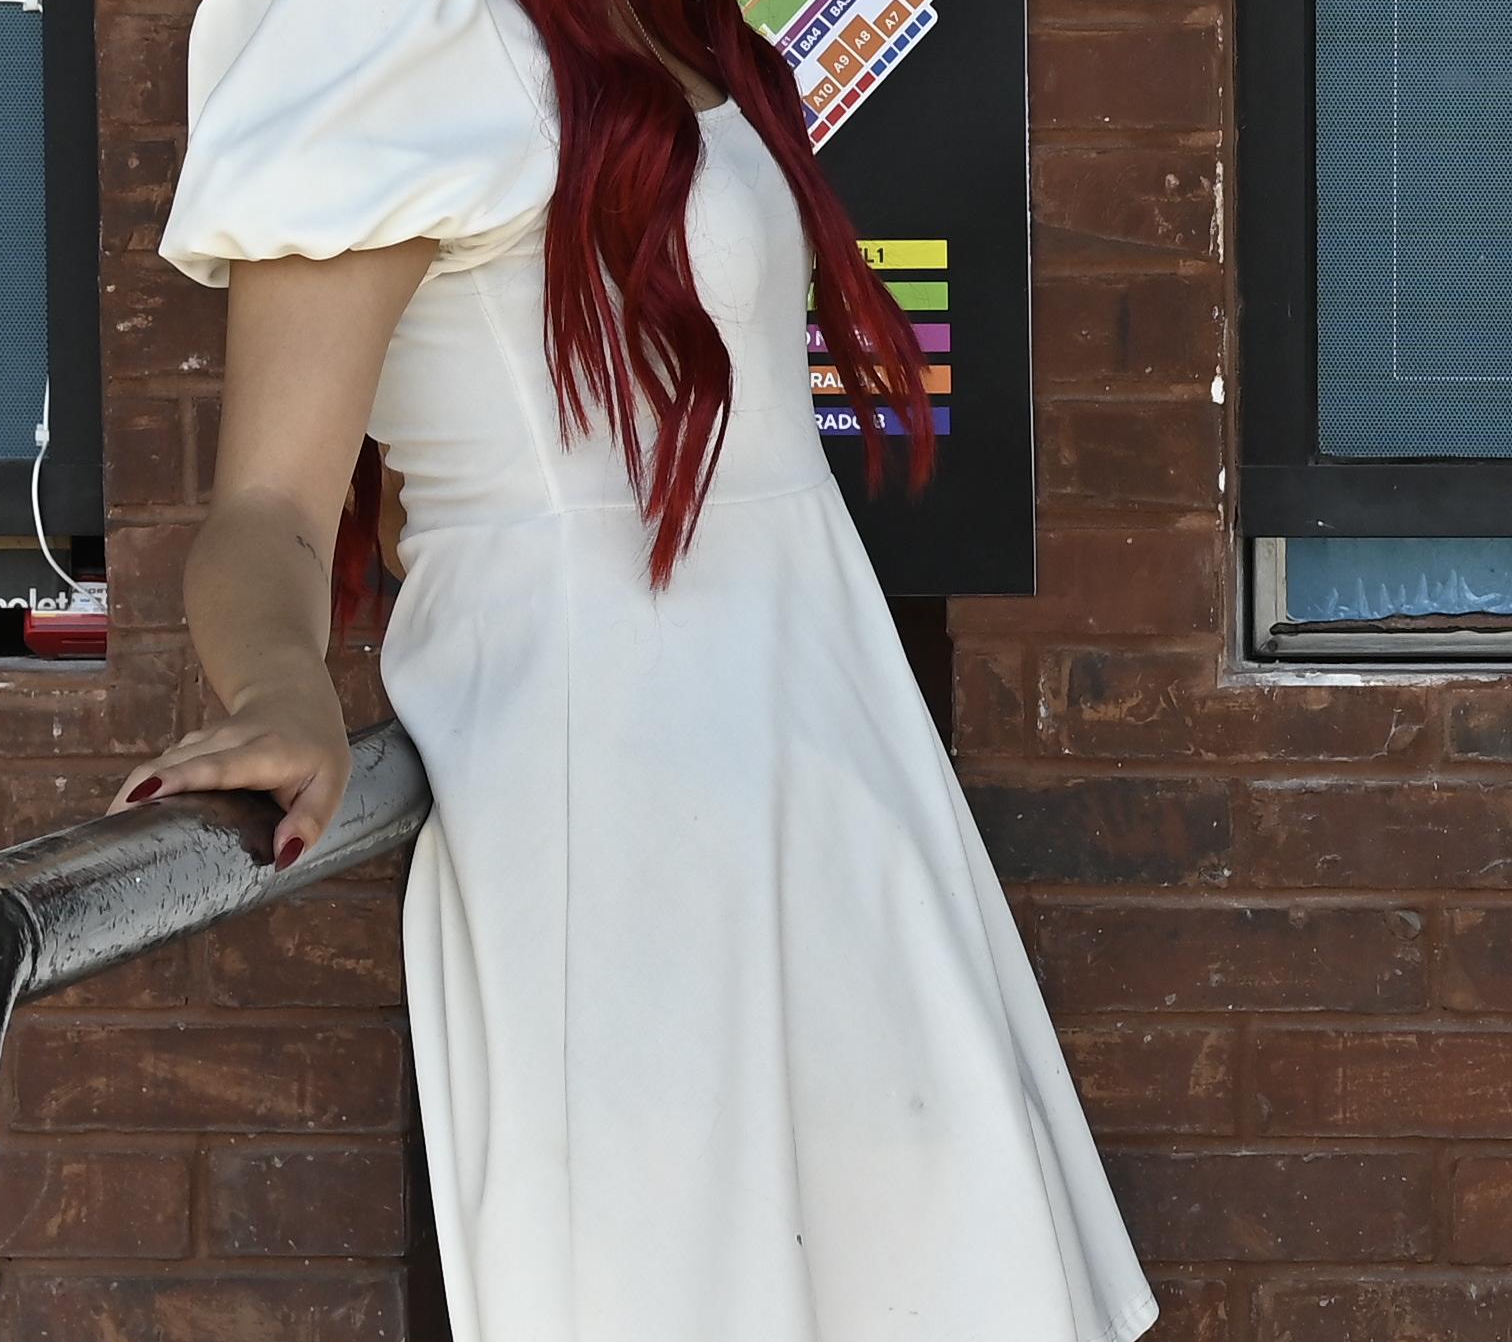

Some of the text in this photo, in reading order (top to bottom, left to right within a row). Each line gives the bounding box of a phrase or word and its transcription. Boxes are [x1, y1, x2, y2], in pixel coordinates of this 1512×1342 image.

[884, 10, 900, 30] A7
[799, 26, 822, 52] BA4
[854, 30, 871, 50] A8
[832, 54, 850, 74] A9
[813, 84, 834, 107] A10
